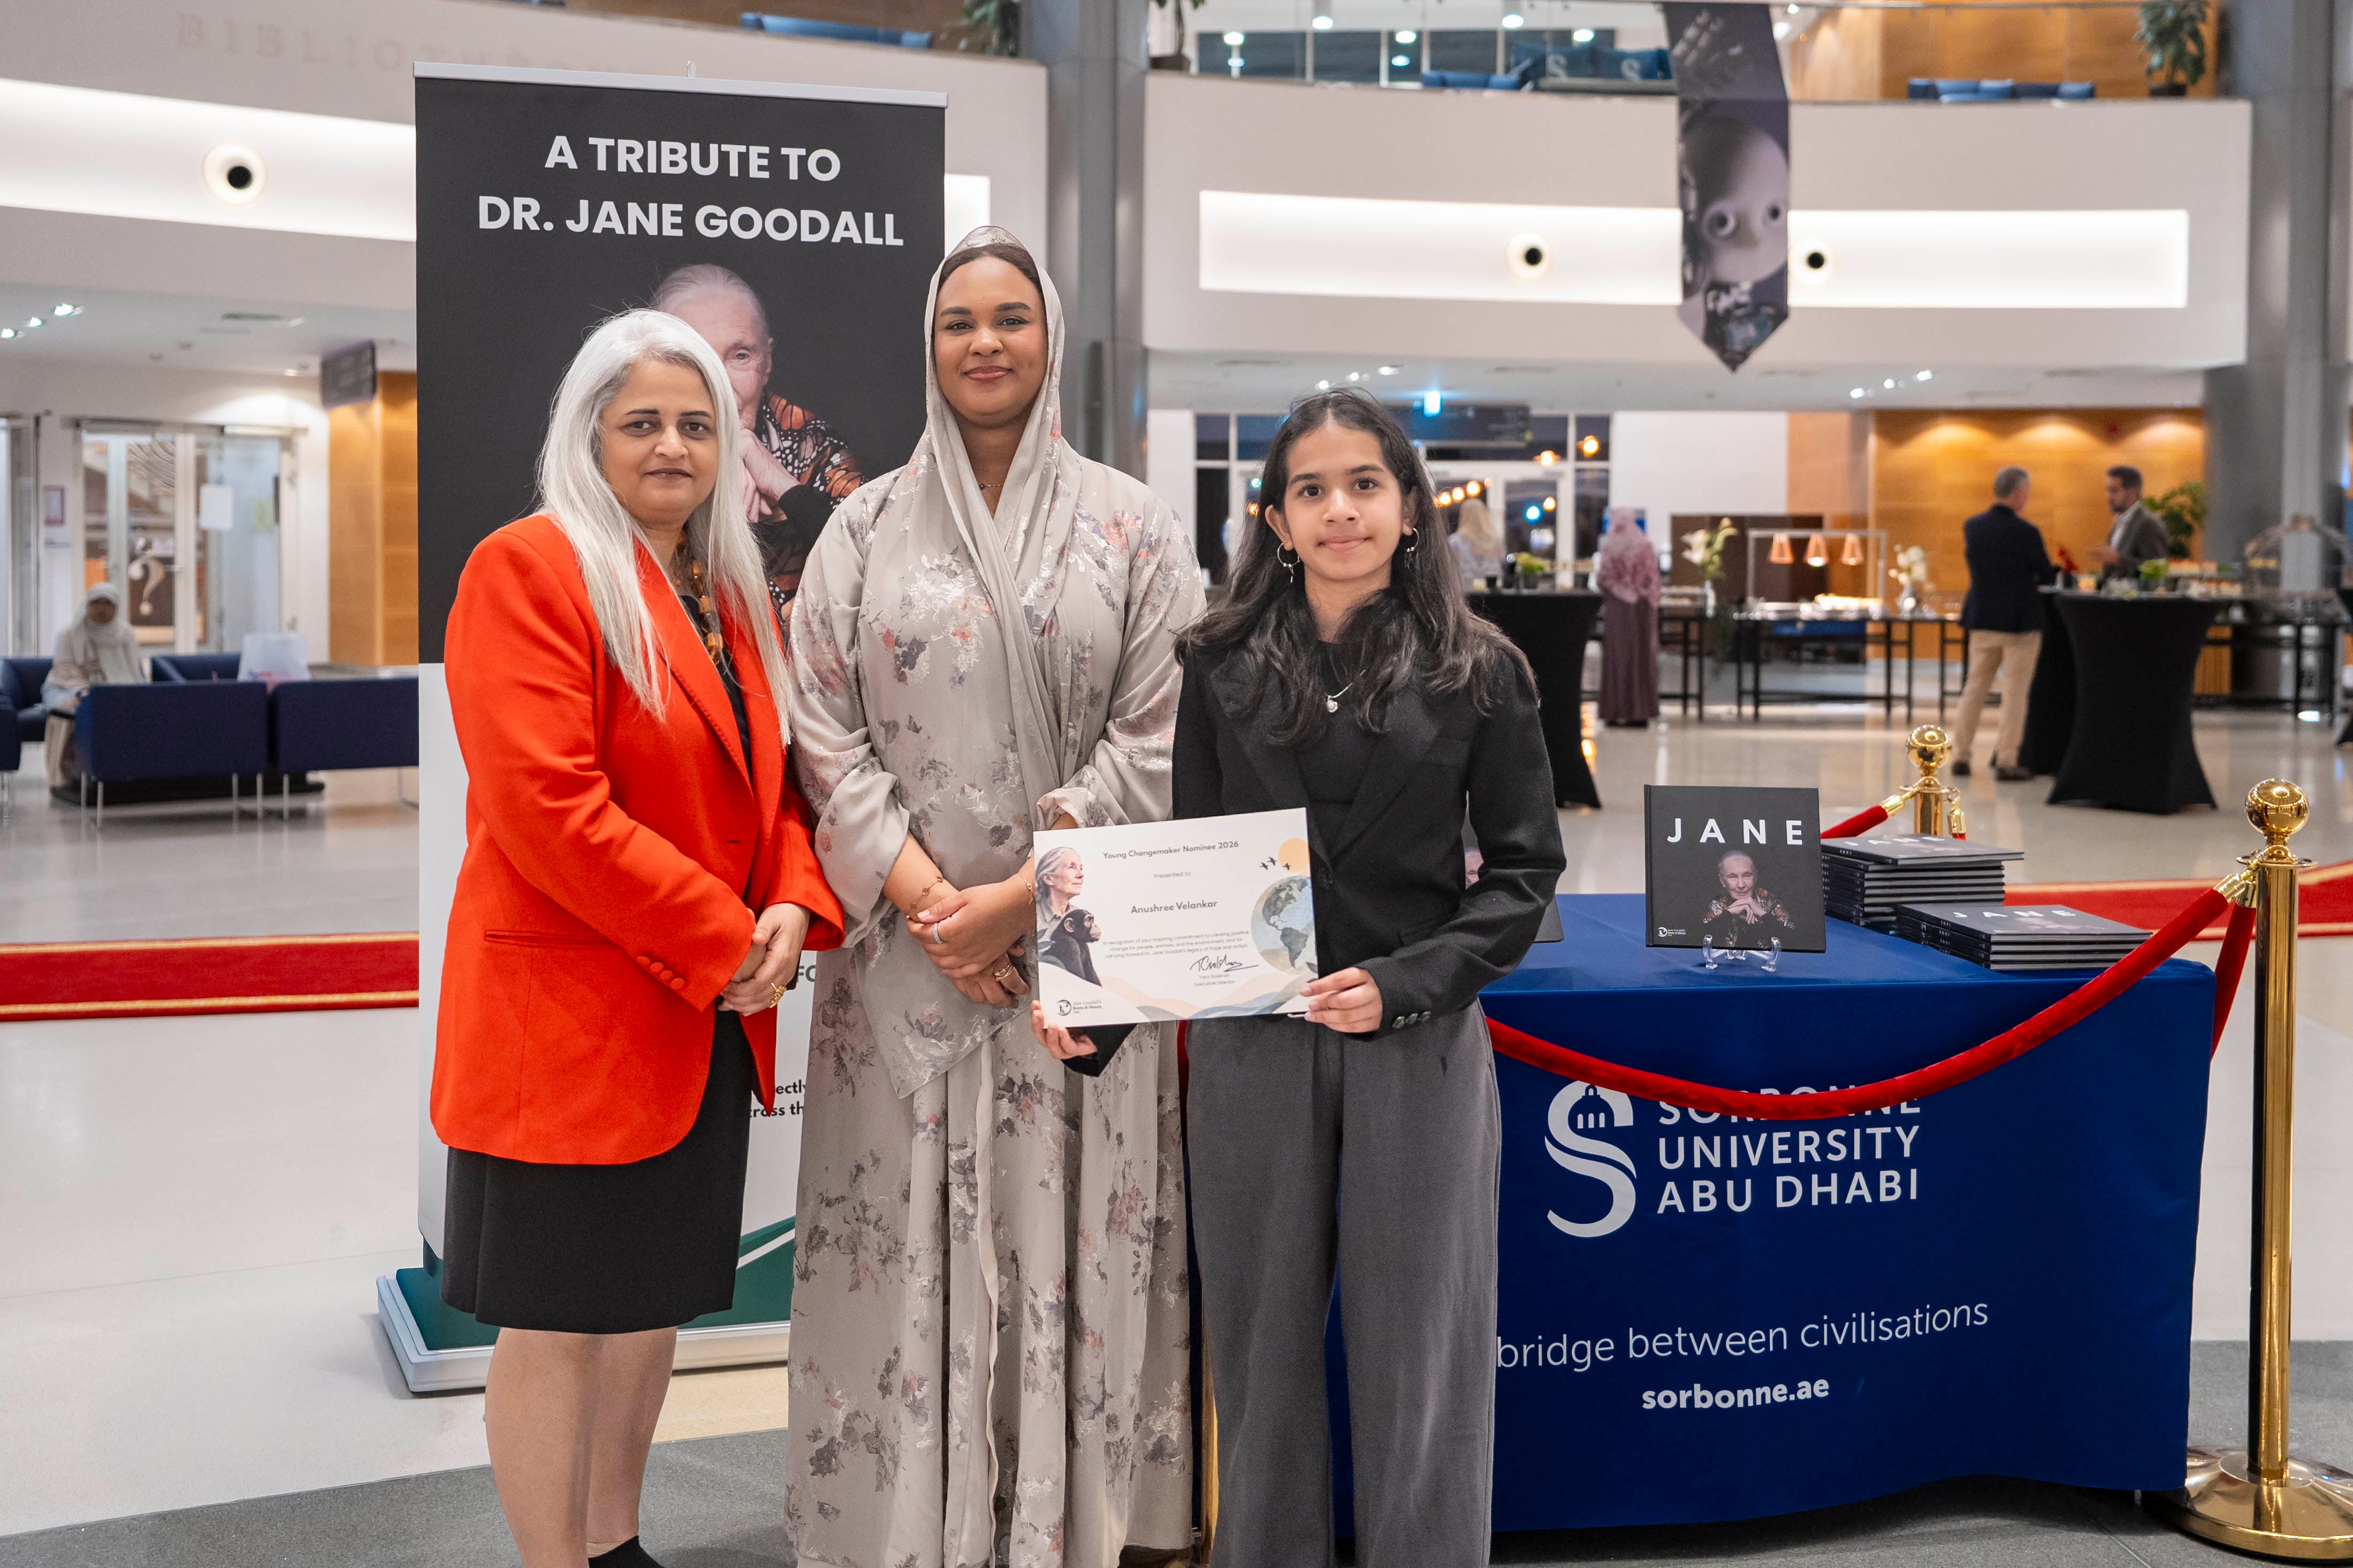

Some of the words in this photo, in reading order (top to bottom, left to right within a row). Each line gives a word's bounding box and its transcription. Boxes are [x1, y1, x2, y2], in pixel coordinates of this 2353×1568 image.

[545, 135, 578, 169] A
[589, 137, 770, 178] TRIBUTE
[781, 147, 841, 181] TO
[479, 195, 553, 232] DR.
[566, 198, 683, 236] JANE
[695, 204, 904, 246] GOODALL
[1666, 818, 1803, 845] JANE
[1844, 836, 1945, 846] JANE
[1129, 846, 1181, 857] Changemaker
[1183, 844, 1216, 852] Nominee
[1218, 840, 1239, 849] 2026
[1154, 871, 1184, 879] Presented
[1131, 904, 1174, 914] Anushree
[1176, 900, 1217, 910] Velankar
[1659, 1126, 1920, 1169] UNIVERSITY
[1657, 1179, 1752, 1213] ABU
[1777, 1168, 1917, 1208] DHABI
[1497, 1334, 1614, 1372] bridge
[1629, 1325, 1787, 1358] between
[1801, 1302, 1989, 1348] civilisations
[1642, 1378, 1830, 1409] sorbonne.ae
